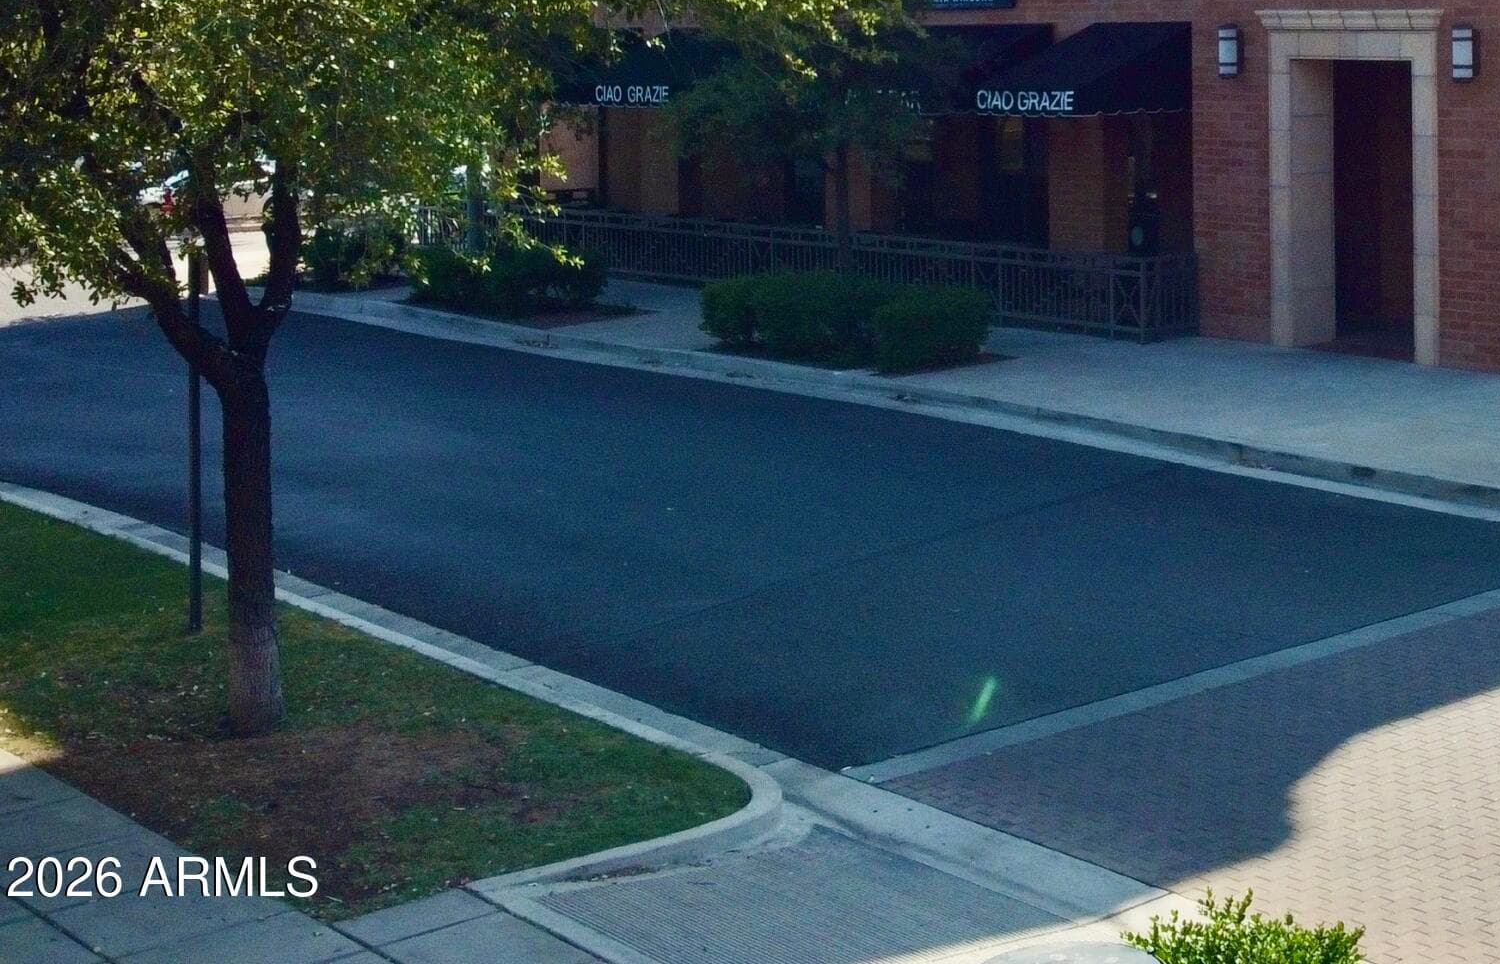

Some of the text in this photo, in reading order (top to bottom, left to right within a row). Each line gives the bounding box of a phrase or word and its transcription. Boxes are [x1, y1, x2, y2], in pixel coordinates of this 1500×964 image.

[595, 85, 669, 103] CIAO GRAZIE
[976, 90, 1074, 111] CIAO GRAZIE
